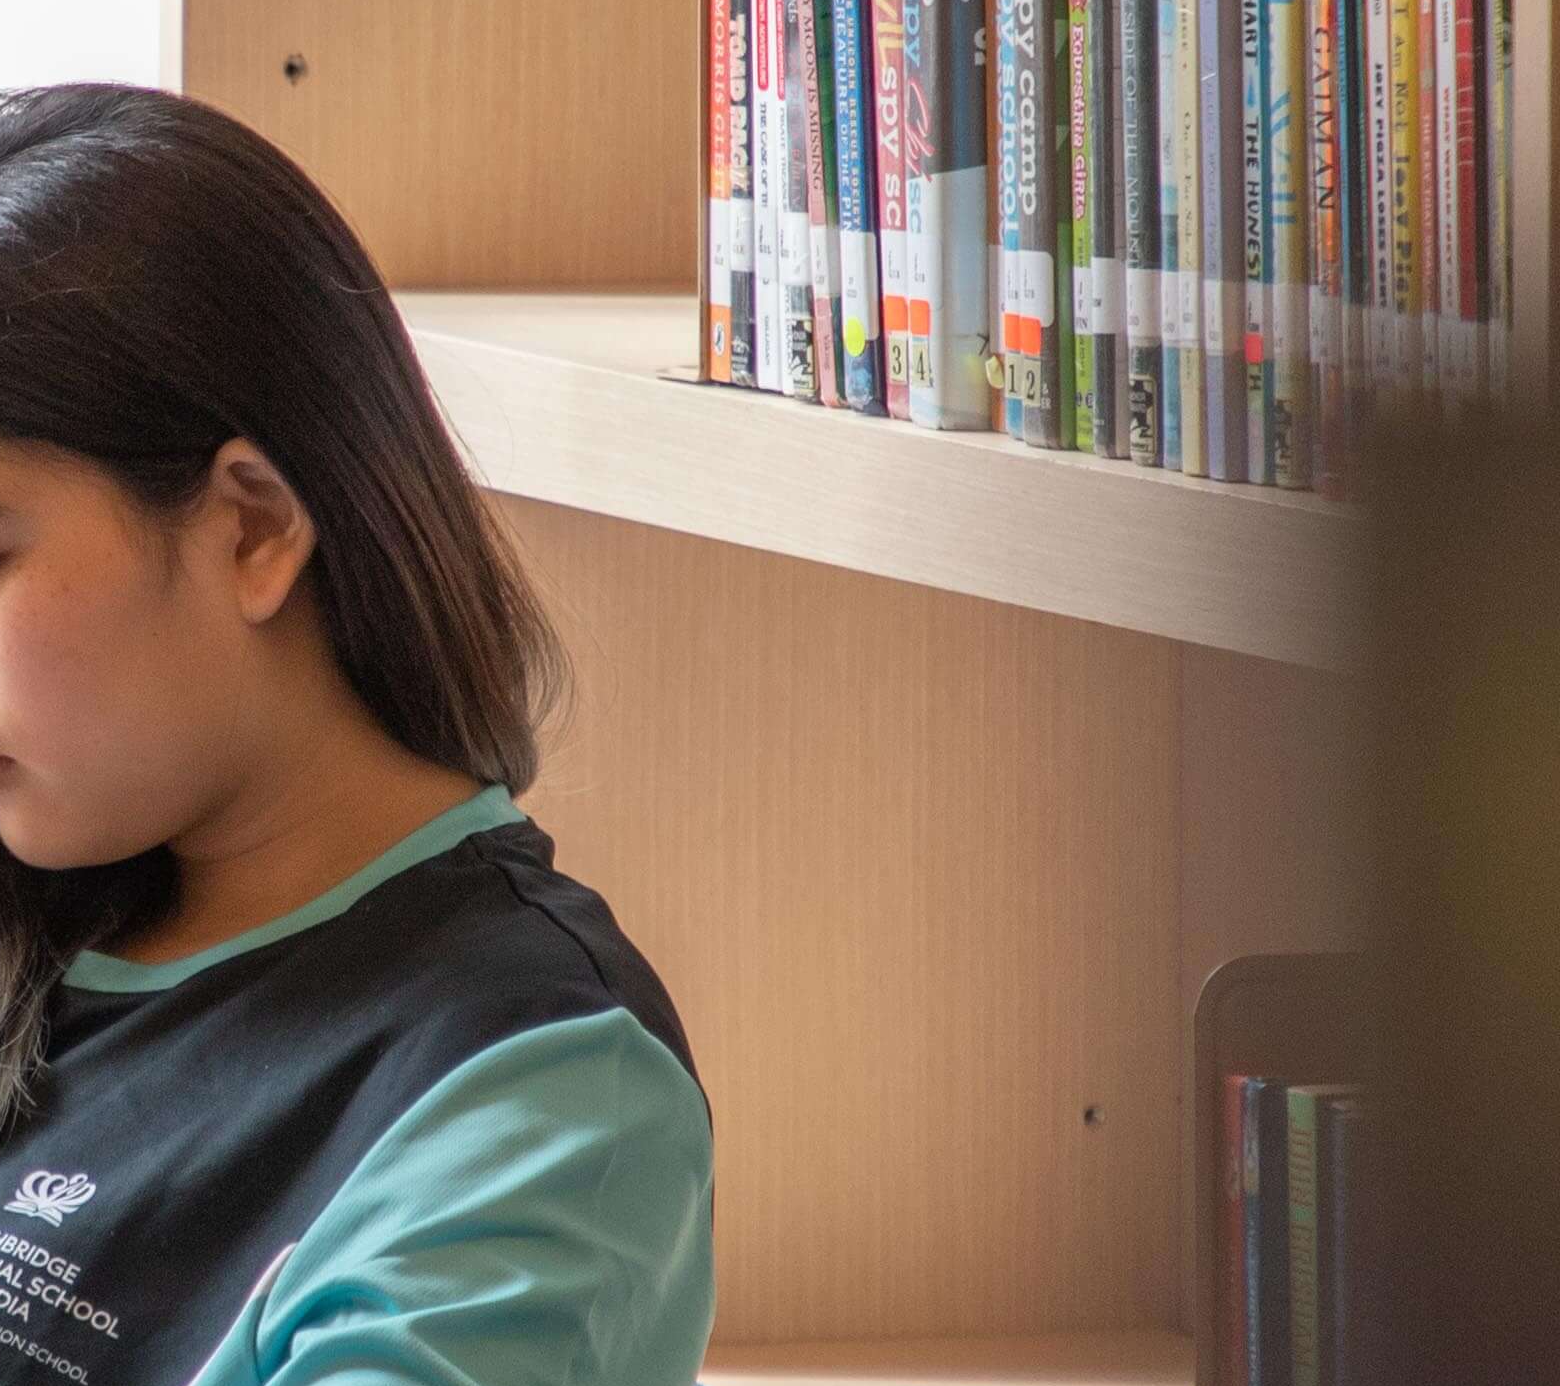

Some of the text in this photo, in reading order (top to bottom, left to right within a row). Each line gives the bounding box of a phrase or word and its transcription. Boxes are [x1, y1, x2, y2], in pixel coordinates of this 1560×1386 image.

[1394, 2, 1410, 18] I
[802, 13, 818, 83] MOON
[846, 15, 860, 89] UNICORN
[1123, 11, 1137, 67] SIDE
[807, 87, 818, 104] IS
[879, 65, 902, 158] spy
[1125, 75, 1139, 111] OF
[1375, 63, 1384, 110] JOEY
[1394, 81, 1410, 133] Not
[758, 101, 768, 129] THE
[840, 124, 850, 143] OF
[849, 98, 862, 159] RESCUE
[1126, 118, 1140, 162] THE
[1314, 27, 1336, 210] GAIMAN
[714, 113, 727, 198] GLEIT
[758, 130, 769, 168] CASE
[809, 108, 823, 191] MISSING
[997, 62, 1018, 239] school
[1018, 68, 1039, 217] camp
[1244, 117, 1259, 173] THE
[840, 149, 852, 193] THE
[841, 199, 855, 233] PIN
[851, 167, 863, 234] SOCIETY
[1127, 176, 1140, 265] MOUN
[1378, 190, 1387, 251] LOSES
[1379, 257, 1388, 308] CONT
[892, 345, 903, 376] 3
[916, 351, 926, 381] 4
[1008, 364, 1018, 395] 1
[1026, 369, 1036, 401] 2
[25, 1276, 120, 1340] SCHOOL
[23, 1342, 90, 1386] SCHOOL
